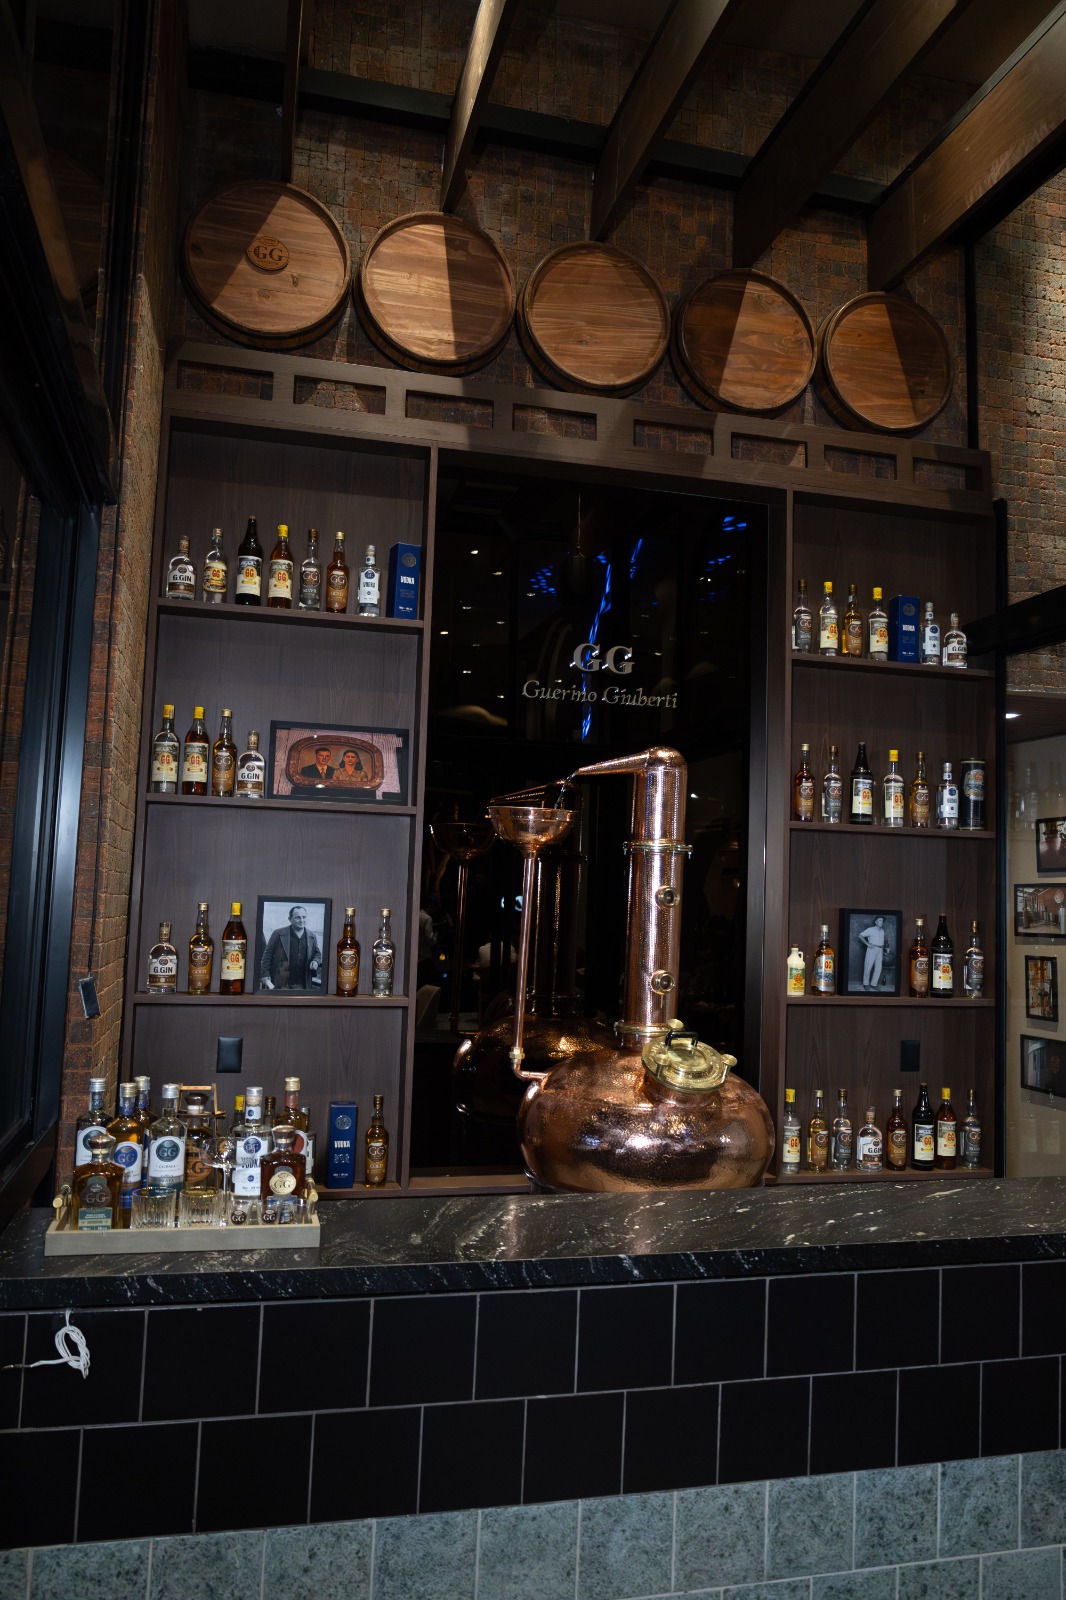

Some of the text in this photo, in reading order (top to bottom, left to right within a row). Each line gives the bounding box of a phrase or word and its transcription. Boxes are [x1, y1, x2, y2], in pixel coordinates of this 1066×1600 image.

[253, 246, 283, 262] GG
[173, 574, 192, 582] G.GIN
[400, 575, 415, 585] VODKA
[572, 643, 635, 675] GG
[521, 679, 677, 708] Guerino Giuberti
[161, 755, 170, 764] GG
[190, 755, 200, 765] GG
[215, 757, 230, 765] GG
[241, 772, 260, 780] G.GIN
[230, 953, 240, 963] GG
[341, 955, 355, 963] GG
[154, 966, 173, 974] G.GIN
[159, 1147, 176, 1158] GG
[369, 1147, 384, 1155] GG
[117, 1153, 135, 1163] GG
[273, 1180, 291, 1189] GG
